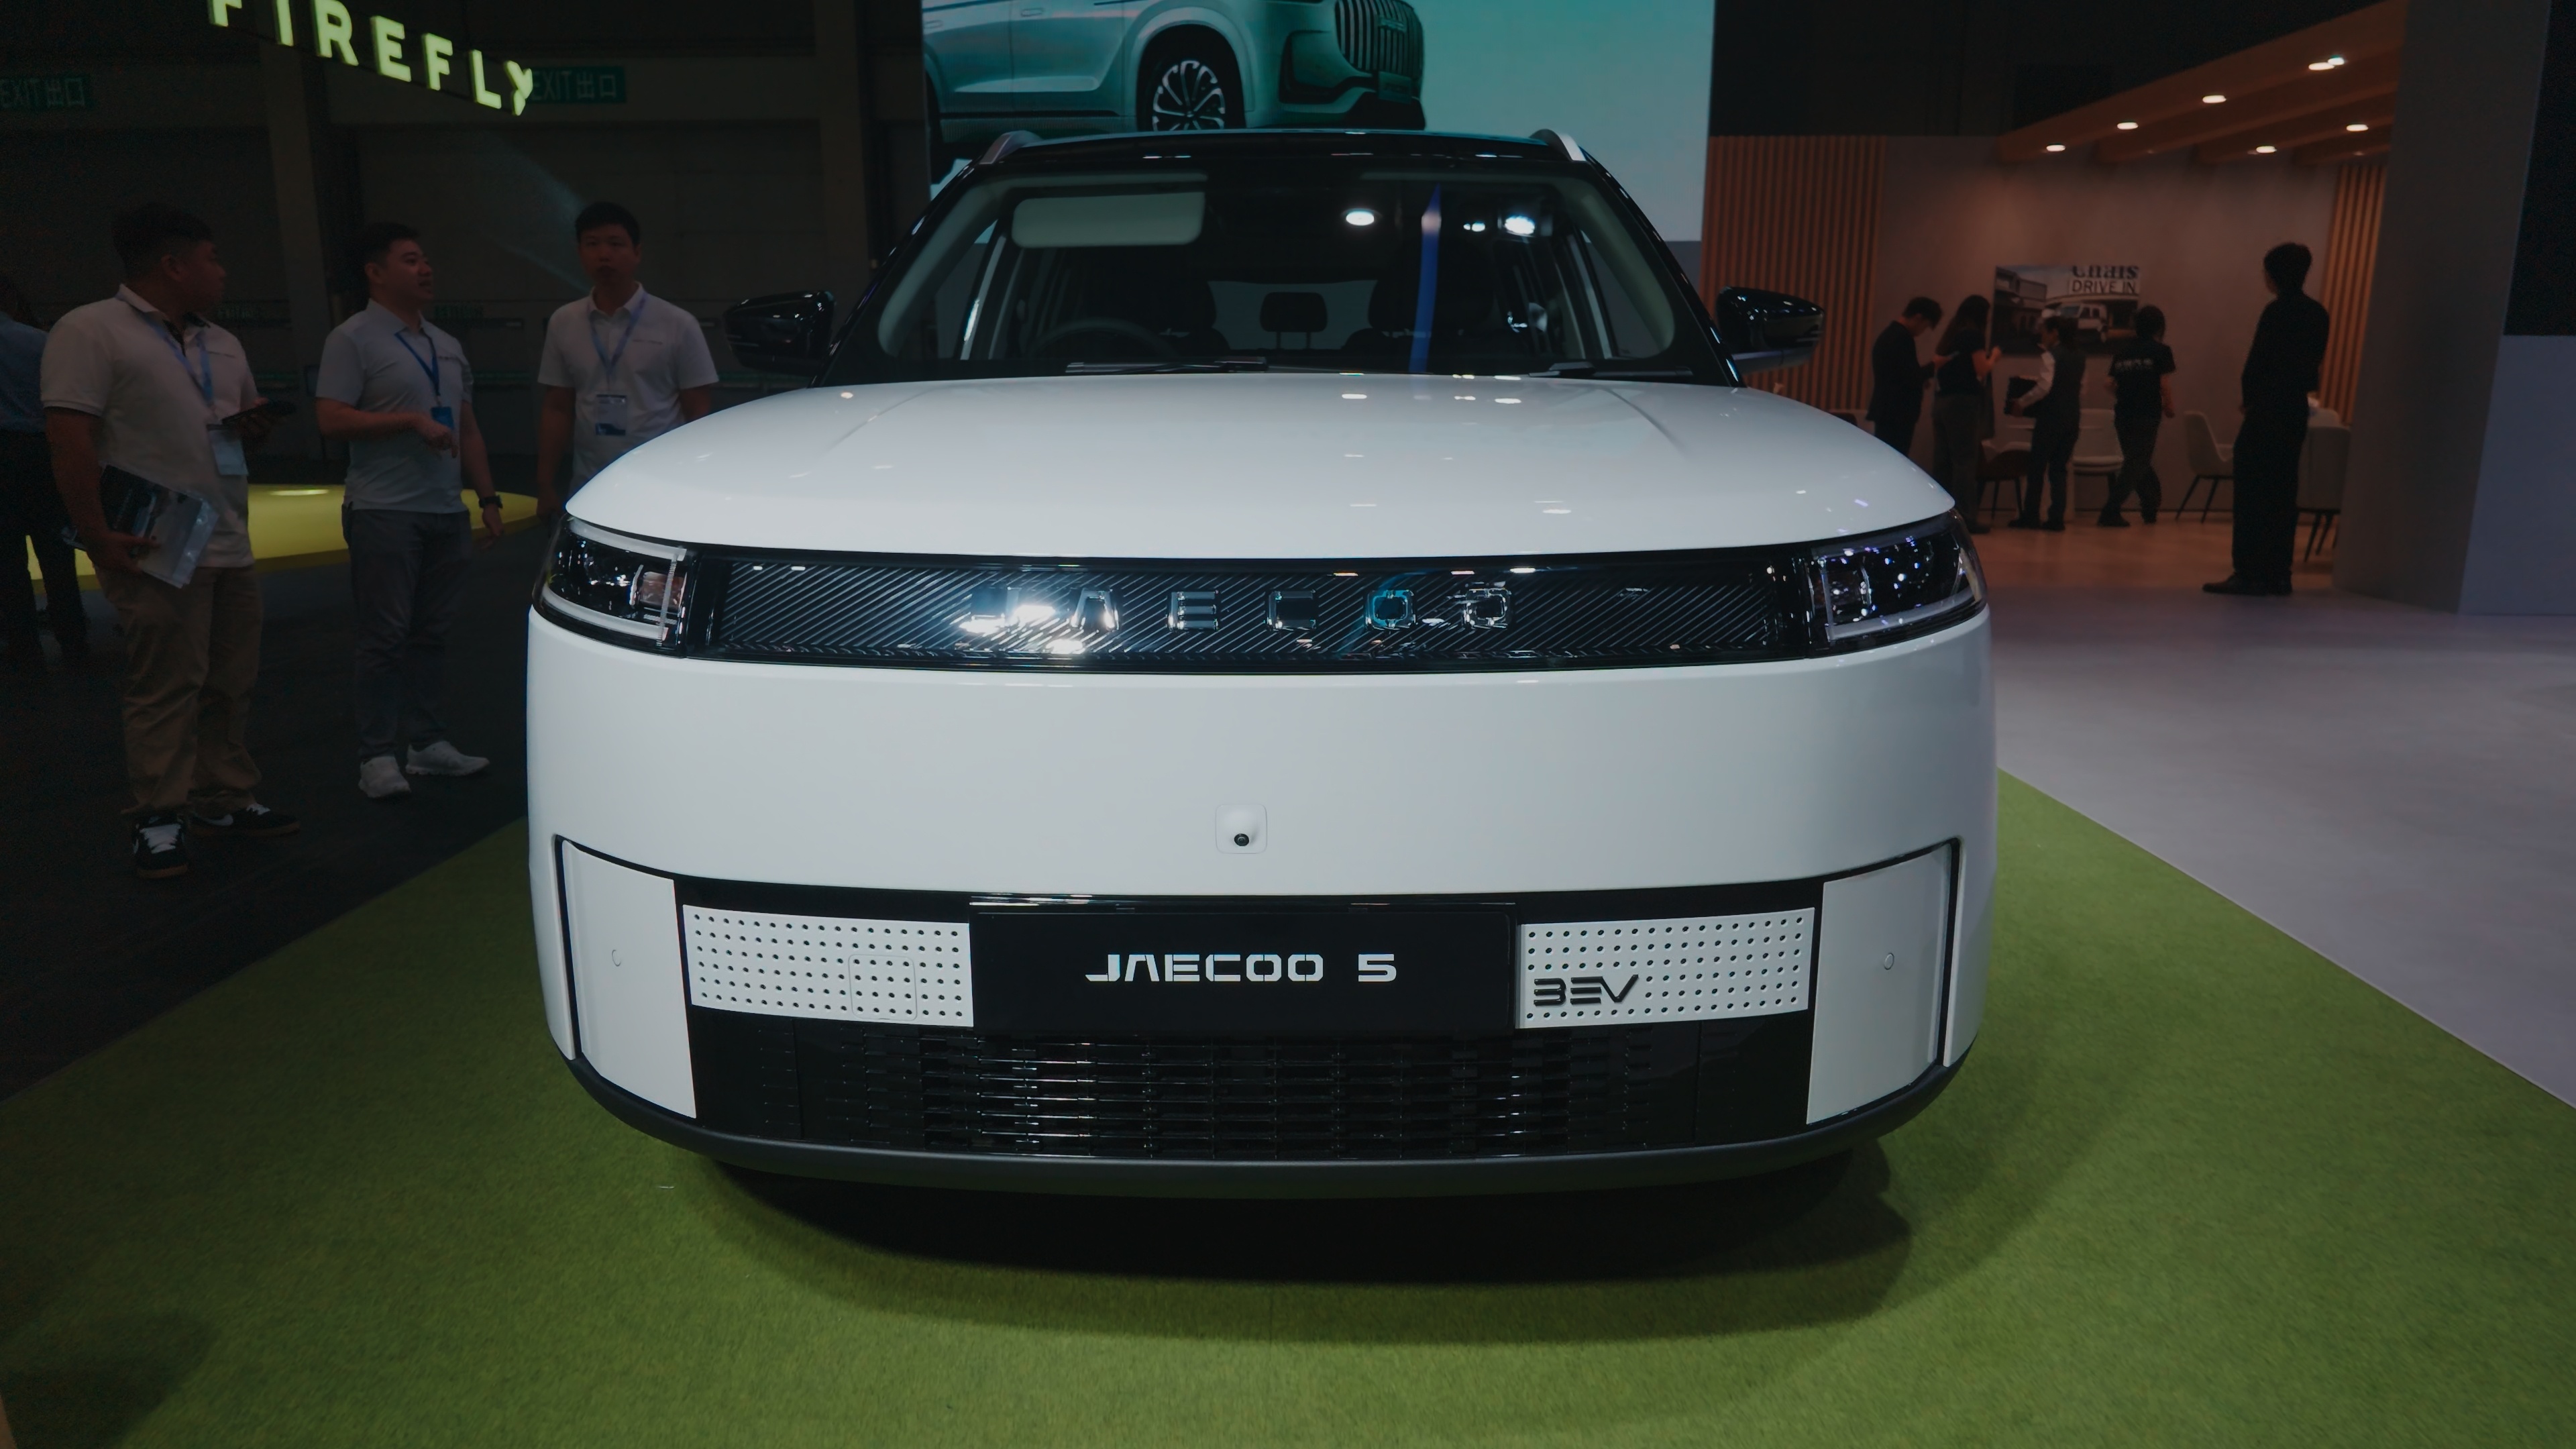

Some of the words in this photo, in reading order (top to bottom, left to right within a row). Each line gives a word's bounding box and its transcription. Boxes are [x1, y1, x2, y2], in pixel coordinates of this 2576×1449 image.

[531, 70, 573, 101] EXIT
[576, 70, 618, 100] 出口
[2072, 280, 2118, 294] DRIVE
[2123, 281, 2137, 295] IN
[961, 587, 1512, 631] JAECOO
[1085, 953, 1324, 982] JAECOO
[1358, 953, 1397, 982] 5
[1534, 974, 1640, 1007] BEV
